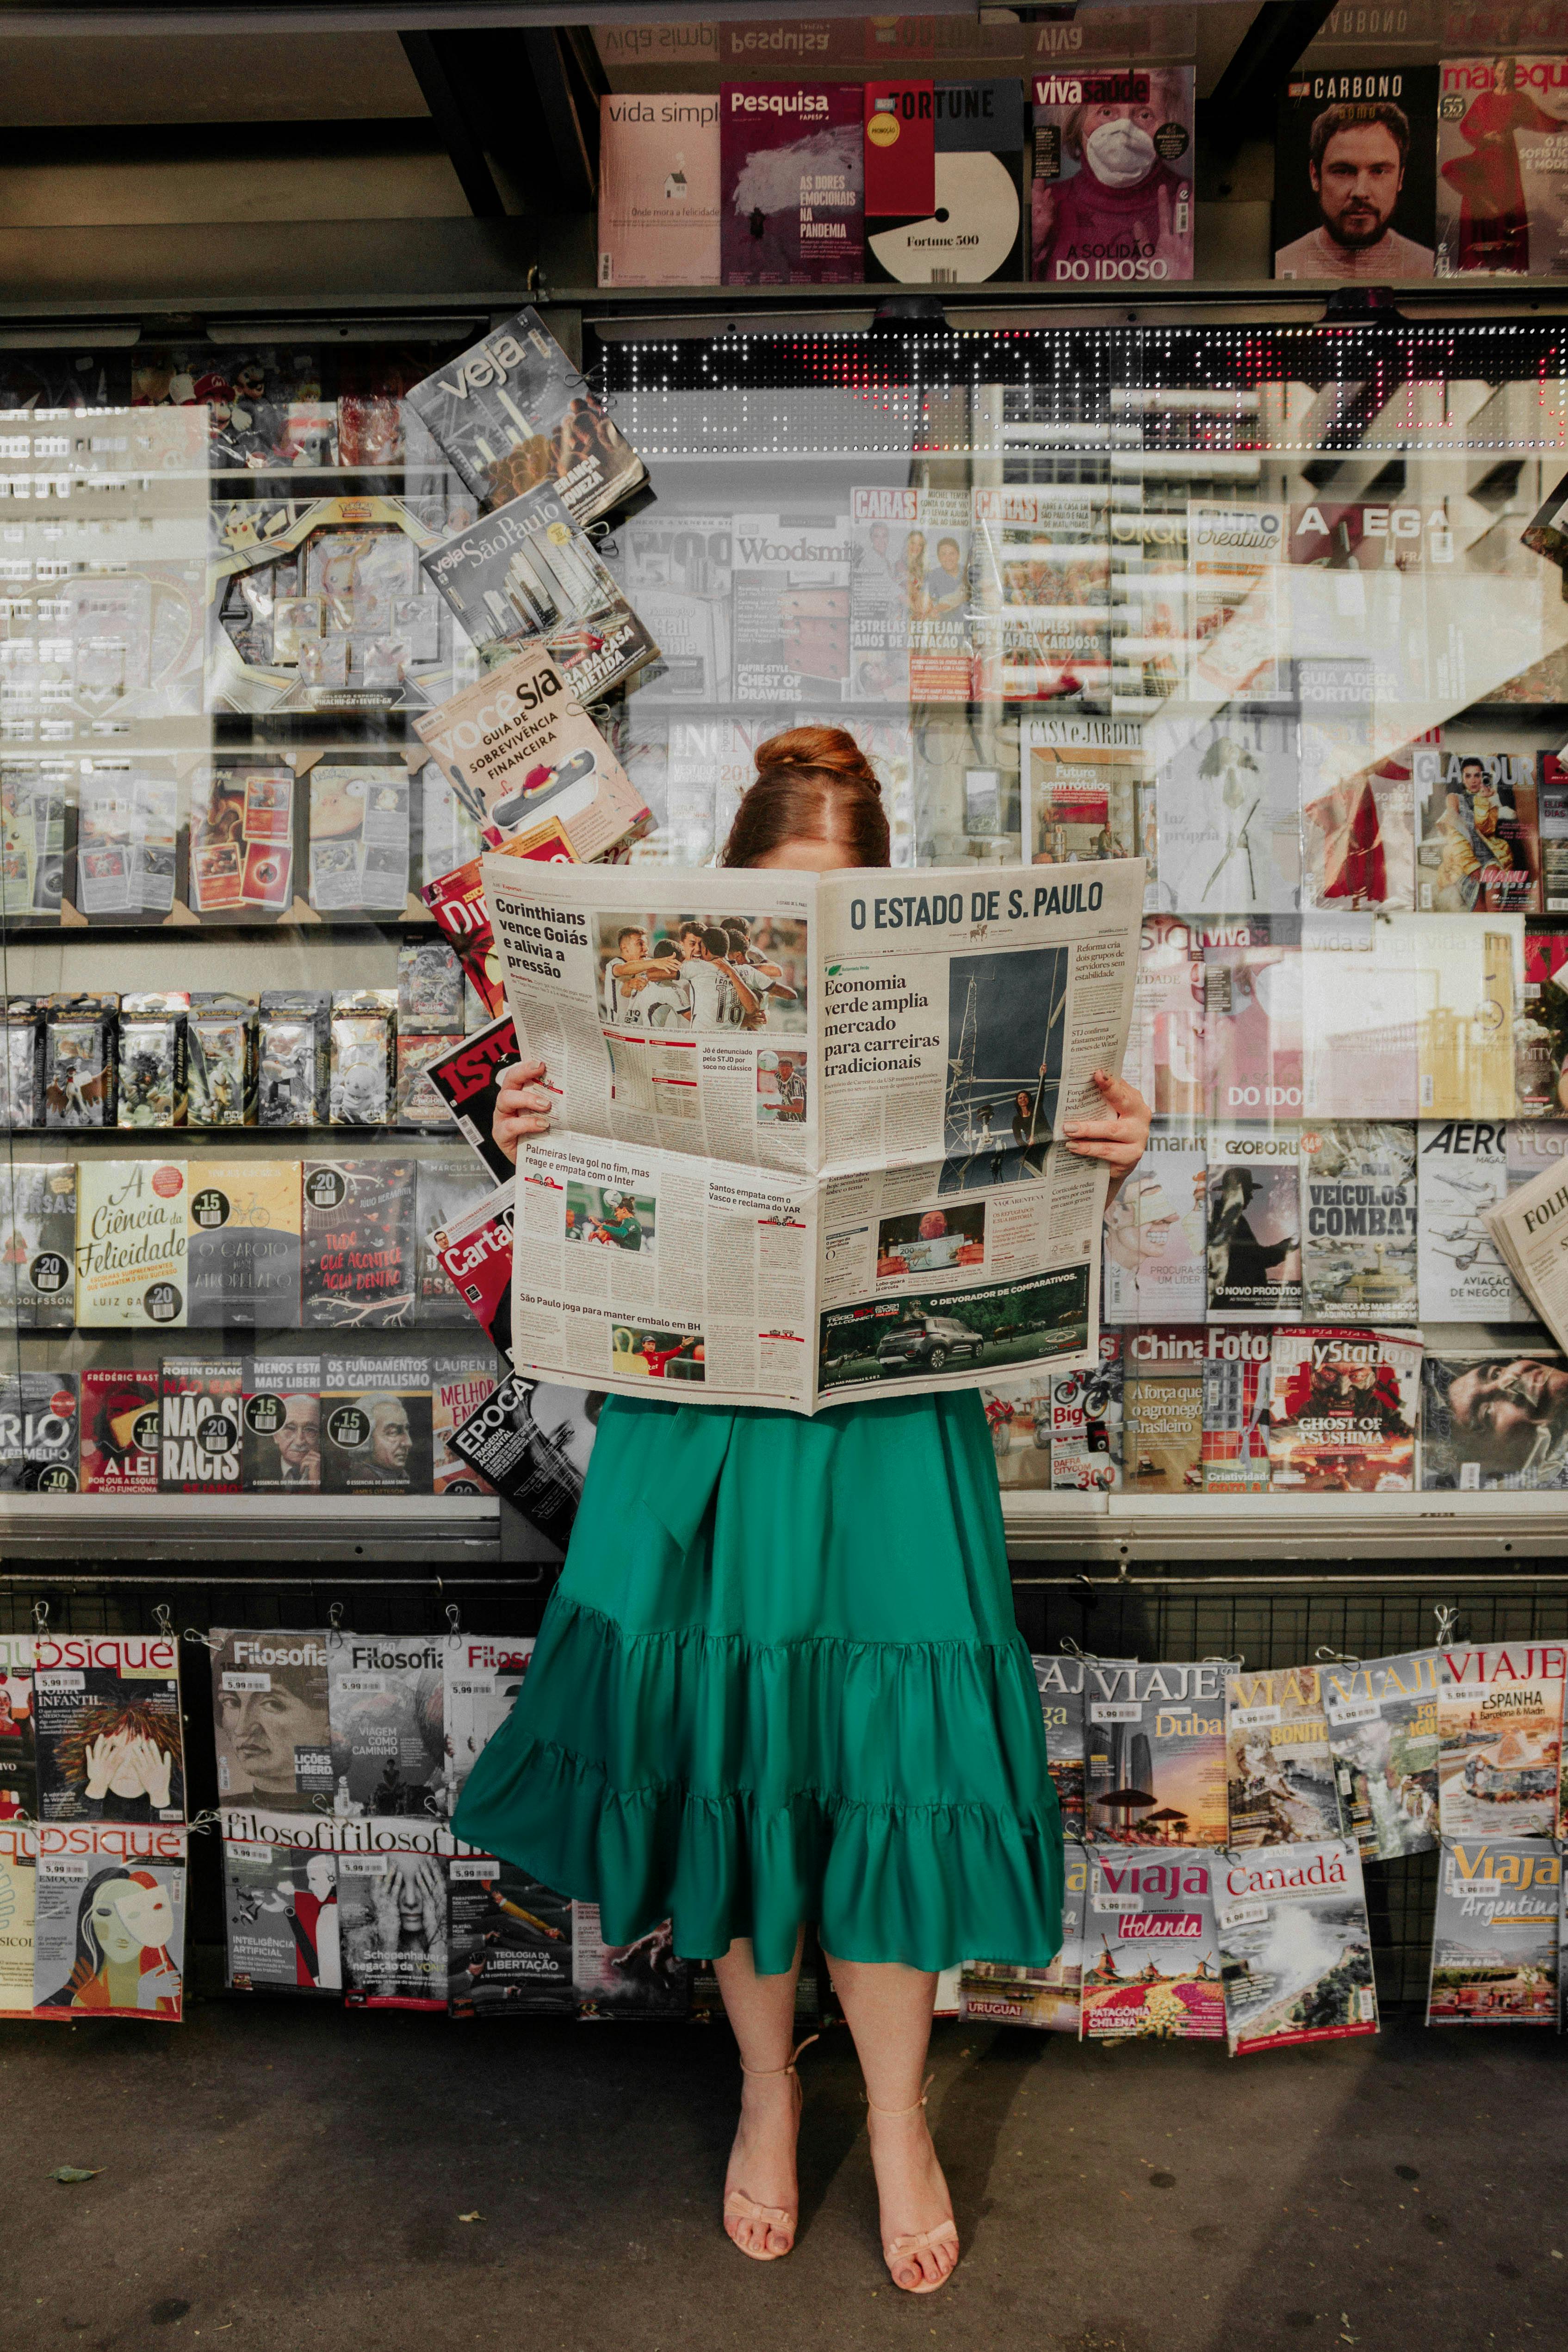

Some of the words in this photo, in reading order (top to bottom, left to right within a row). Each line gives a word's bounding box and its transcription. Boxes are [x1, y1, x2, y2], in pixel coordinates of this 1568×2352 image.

[1314, 75, 1403, 99] CARBONO
[609, 102, 655, 122] vida
[731, 91, 829, 115] Pesquisa
[888, 89, 994, 120] FORTUNE
[800, 176, 812, 190] AS
[815, 175, 845, 190] DORES
[800, 191, 856, 206] EMOCIONAIS
[800, 208, 813, 223] NA
[800, 223, 847, 239] PANDEMIA
[907, 235, 954, 247] Fortune
[956, 235, 979, 246] 500
[1067, 244, 1078, 258] A
[1082, 239, 1156, 259] SOLIDÃO
[1056, 259, 1090, 281] DO
[1095, 258, 1168, 280] IDOSO
[437, 335, 527, 400] veja
[855, 490, 917, 519] CARAS
[430, 549, 466, 574] veja
[854, 619, 906, 634] ESTRELAS
[582, 651, 602, 672] DA
[601, 625, 635, 658] CASA
[738, 674, 781, 688] CHEST
[783, 674, 802, 687] OF
[738, 687, 802, 701] DRAWERS
[1298, 687, 1398, 702] PORTUGAL
[512, 711, 529, 728] DE
[469, 712, 559, 774] SOBREVIVÊNCIA
[482, 724, 513, 747] GUIA
[1029, 721, 1067, 743] CASA
[1082, 722, 1141, 746] JARDIM
[486, 732, 558, 781] FINANCEIRA
[1417, 754, 1534, 786] GLAOUR
[1068, 778, 1111, 792] rótulos
[495, 897, 586, 926] Corinthians
[850, 899, 867, 930] O
[874, 893, 963, 929] ESTADO
[972, 891, 1000, 922] DE
[1008, 889, 1029, 920] S.
[1033, 881, 1103, 917] PAULO
[498, 919, 542, 939] vence
[543, 927, 588, 946] Goiás
[503, 937, 512, 949] e
[514, 940, 553, 960] alivia
[555, 950, 565, 962] a
[1077, 944, 1107, 953] Reforma
[507, 954, 562, 979] pressão
[824, 974, 907, 997] Economia
[824, 997, 869, 1016] verde
[872, 993, 929, 1017] amplia
[824, 1017, 896, 1037] mercado
[716, 1047, 753, 1057] denunciado
[824, 1043, 861, 1062] para
[864, 1034, 940, 1053] carreiras
[717, 1055, 734, 1064] STJD
[824, 1054, 922, 1077] tradicionais
[1229, 1087, 1261, 1107] DO
[525, 1143, 567, 1162] Palmeiras
[568, 1152, 585, 1165] leva
[586, 1156, 600, 1170] gol
[601, 1160, 612, 1170] no
[613, 1161, 630, 1175] fim,
[631, 1166, 650, 1178] mas
[709, 1182, 736, 1196] Santos
[736, 1187, 766, 1201] empata
[1309, 1181, 1408, 1206] VEÍCULOS
[708, 1192, 731, 1204] Vasco
[783, 1206, 801, 1214] VAR
[91, 1204, 169, 1241] Ciência
[170, 1211, 183, 1226] da
[221, 1243, 288, 1258] GAROTO
[325, 1231, 357, 1250] TUDO
[76, 1228, 188, 1278] Felicidade
[320, 1254, 343, 1270] QUE
[347, 1246, 403, 1270] ACONTECE
[195, 1273, 292, 1289] ATROPELADO
[322, 1273, 352, 1290] AQUI
[356, 1269, 401, 1291] DENTRO
[939, 1289, 996, 1306] DEVORADOR
[997, 1288, 1009, 1297] DE
[1010, 1273, 1078, 1294] COMPARATIVOS.
[1225, 1287, 1252, 1296] NOVO
[93, 1297, 119, 1307] LUIZ
[520, 1293, 536, 1304] São
[537, 1296, 561, 1310] Paulo
[562, 1301, 581, 1313] joga
[582, 1305, 602, 1317] para
[603, 1309, 636, 1323] manter
[637, 1315, 670, 1327] embalo
[671, 1321, 686, 1329] em
[688, 1322, 701, 1331] BH
[1131, 1334, 1203, 1361] China
[1209, 1327, 1269, 1362] Foto
[1275, 1339, 1416, 1370] PlayStation
[162, 1366, 205, 1375] ROBIN
[253, 1362, 293, 1374] MENOS
[328, 1360, 343, 1372] OS
[346, 1360, 428, 1373] FUNDAMENTOS
[435, 1361, 486, 1372] LAUREN
[87, 1373, 133, 1382] FRÉDÉRIC
[255, 1376, 283, 1388] MAIS
[326, 1374, 346, 1387] DO
[348, 1374, 430, 1387] CAPITALISMO
[1145, 1387, 1178, 1403] força
[455, 1378, 534, 1455] ÉPOCA
[1298, 1417, 1350, 1431] GHOST
[1359, 1417, 1382, 1430] OF
[471, 1427, 507, 1461] TRAGÉDIA
[1296, 1431, 1385, 1445] TSUSHIMA
[478, 1430, 514, 1467] ACIDENTAL
[104, 1459, 119, 1476] A
[124, 1456, 155, 1476] LEI
[1054, 1456, 1081, 1468] DAFRA
[1078, 1466, 1116, 1490] 300
[35, 1641, 174, 1679] psique
[234, 1641, 327, 1666] Filosofia
[1442, 1647, 1567, 1684] VIAJE
[1091, 1668, 1221, 1703] VIAJE
[38, 1696, 102, 1707] INFANTIL
[1481, 1690, 1543, 1710] ESPANHA
[359, 1727, 397, 1736] VIAGEM
[368, 1737, 397, 1746] COMO
[352, 1746, 398, 1756] CAMINHO
[40, 1827, 181, 1864] psique
[1226, 1852, 1348, 1896] Canadá
[1450, 1844, 1561, 1891] Viaja
[1098, 1855, 1209, 1901] Viaja
[1120, 1914, 1201, 1938] Holanda
[232, 1936, 295, 1948] INTELIGÊNCIA
[232, 1946, 282, 1957] ARTIFICIAL
[363, 1950, 440, 1963] Schopenhauer
[495, 1950, 536, 1960] TEOLOGIA
[487, 1959, 559, 1972] LIBERTAÇÃO
[967, 2001, 1021, 2017] URUGUAI
[1089, 2005, 1151, 2019] PATAGÔNIA
[1088, 2018, 1137, 2028] CHILENA
